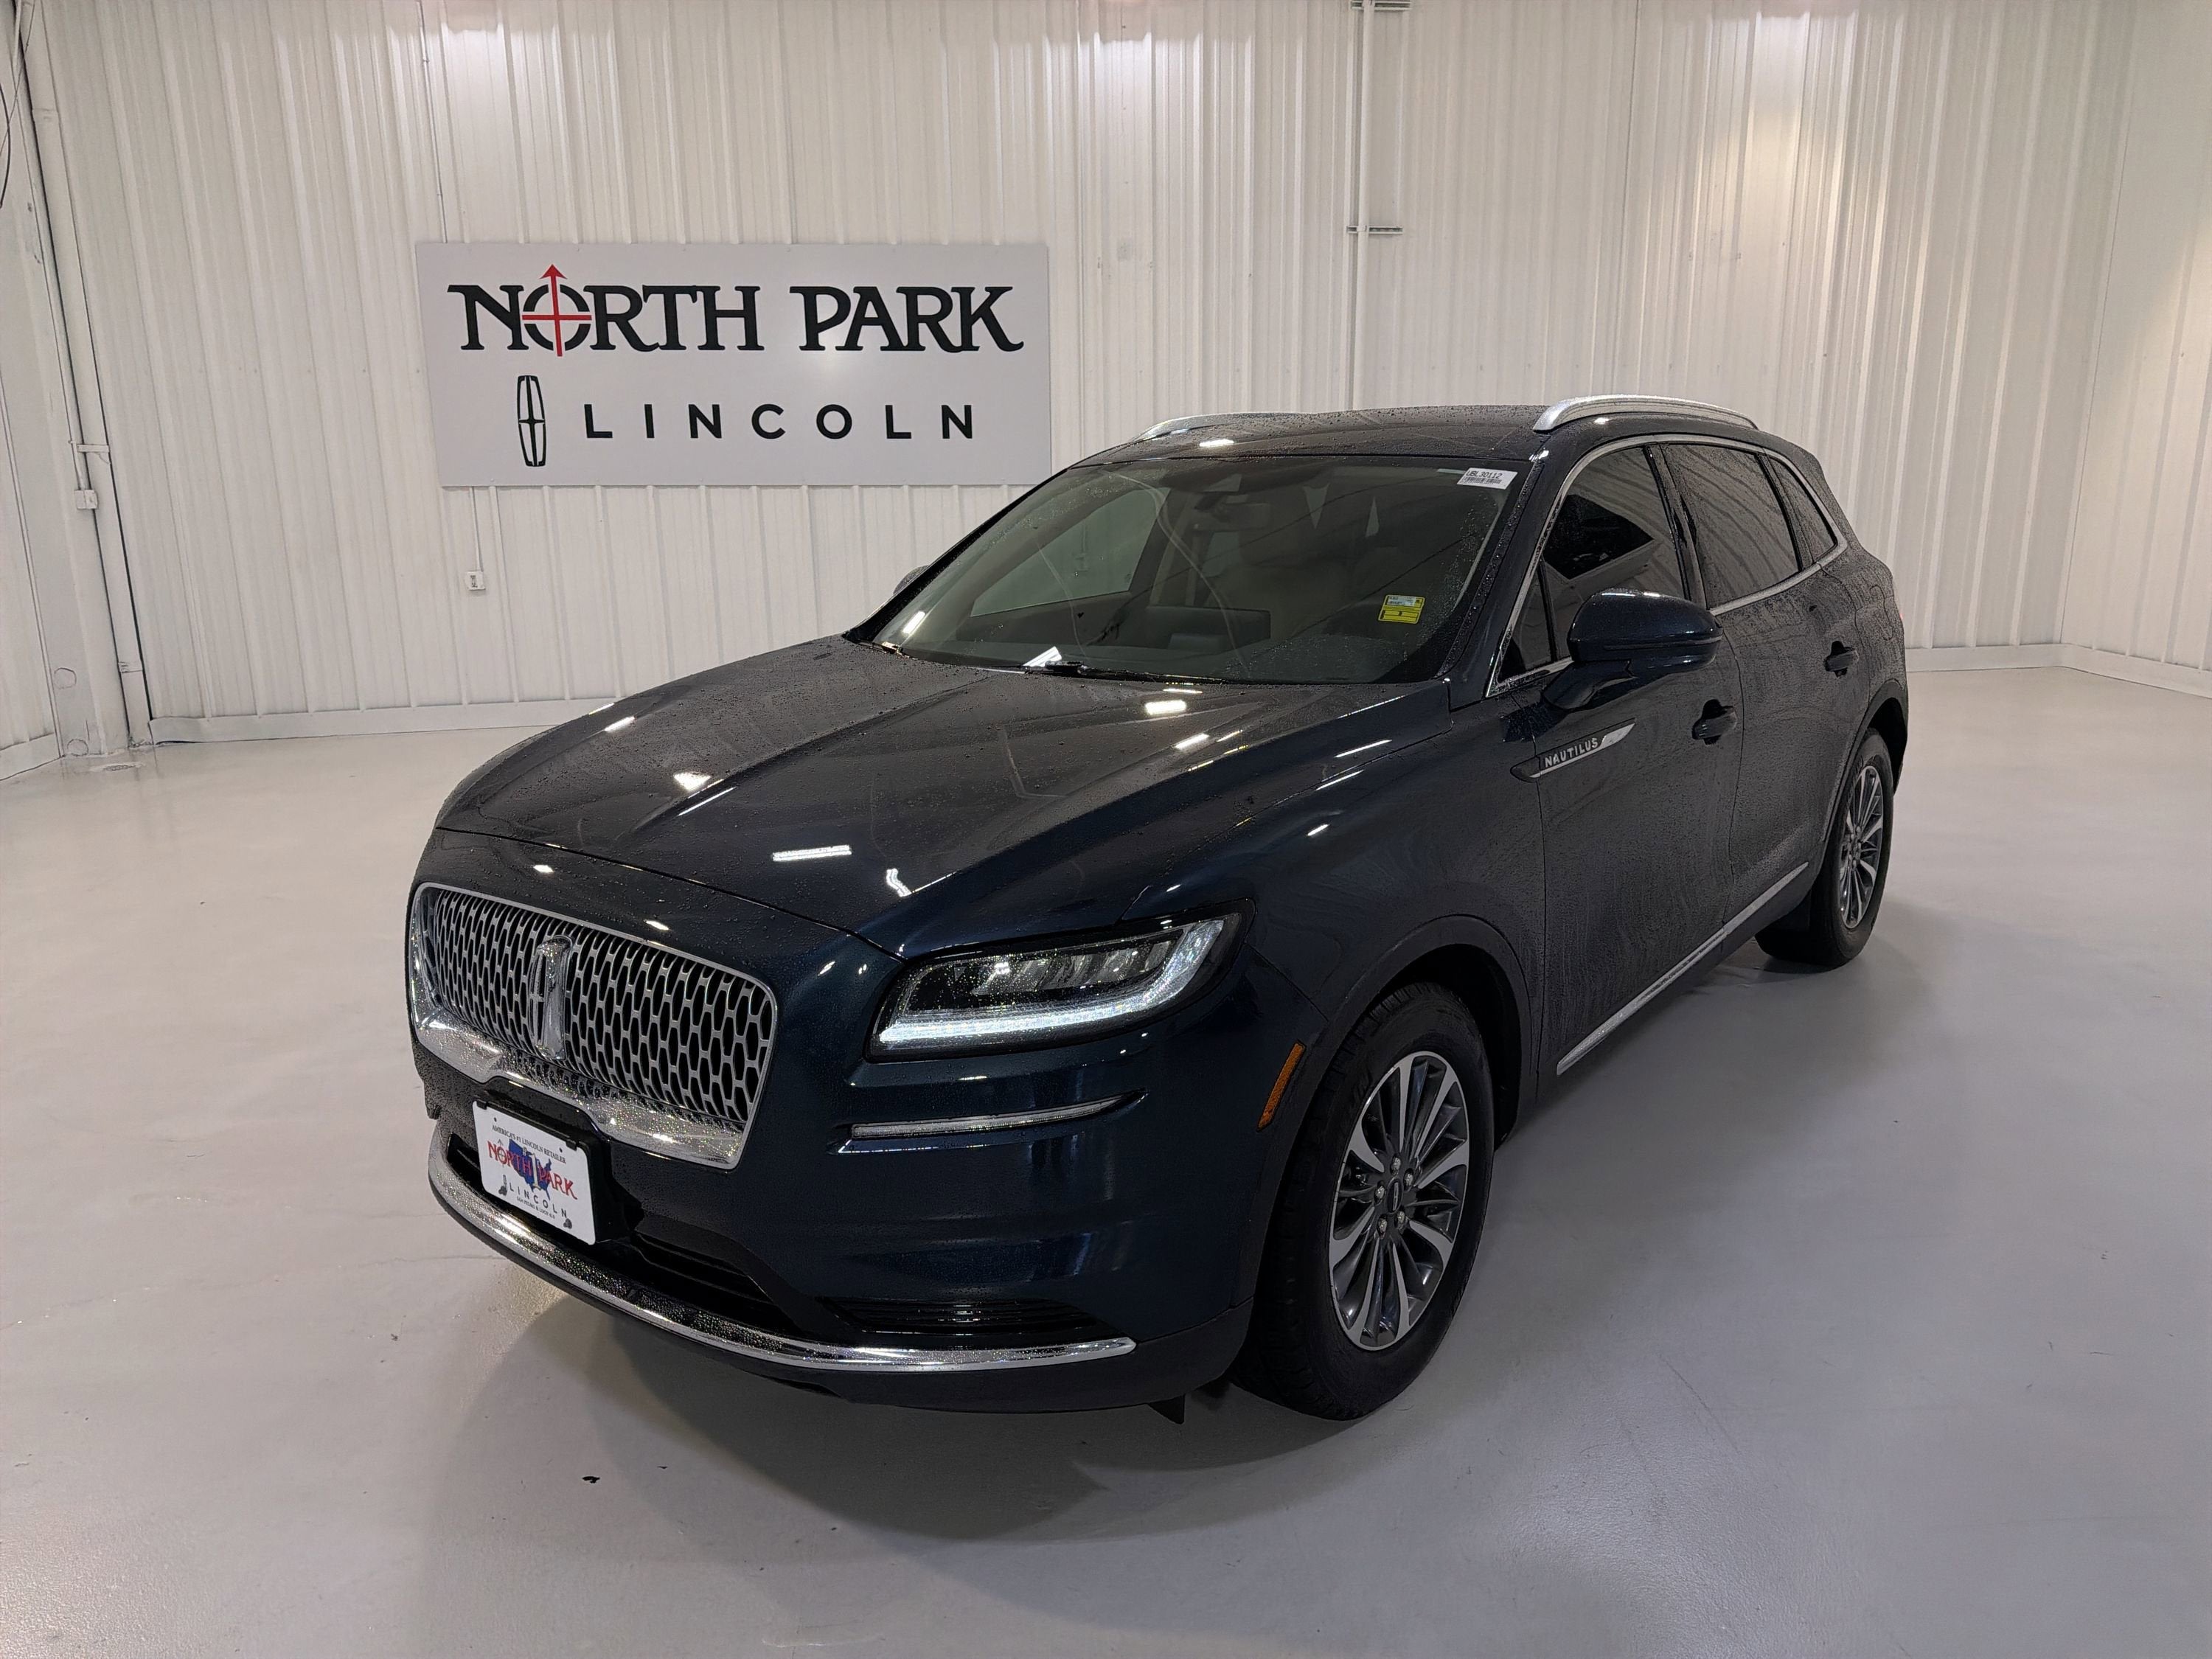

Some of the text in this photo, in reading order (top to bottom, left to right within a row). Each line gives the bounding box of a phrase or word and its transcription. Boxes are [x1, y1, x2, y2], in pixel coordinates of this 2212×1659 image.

[447, 284, 1024, 352] NORTH PARK
[584, 403, 973, 440] LINCOLN
[1545, 737, 1598, 768] NAUTILUS
[492, 1124, 516, 1140] AMERICA'S
[522, 1138, 543, 1152] LINCOLN
[543, 1148, 566, 1164] RETAILER
[487, 1140, 578, 1200] NORTH PARK
[509, 1182, 567, 1219] LINCOLN
